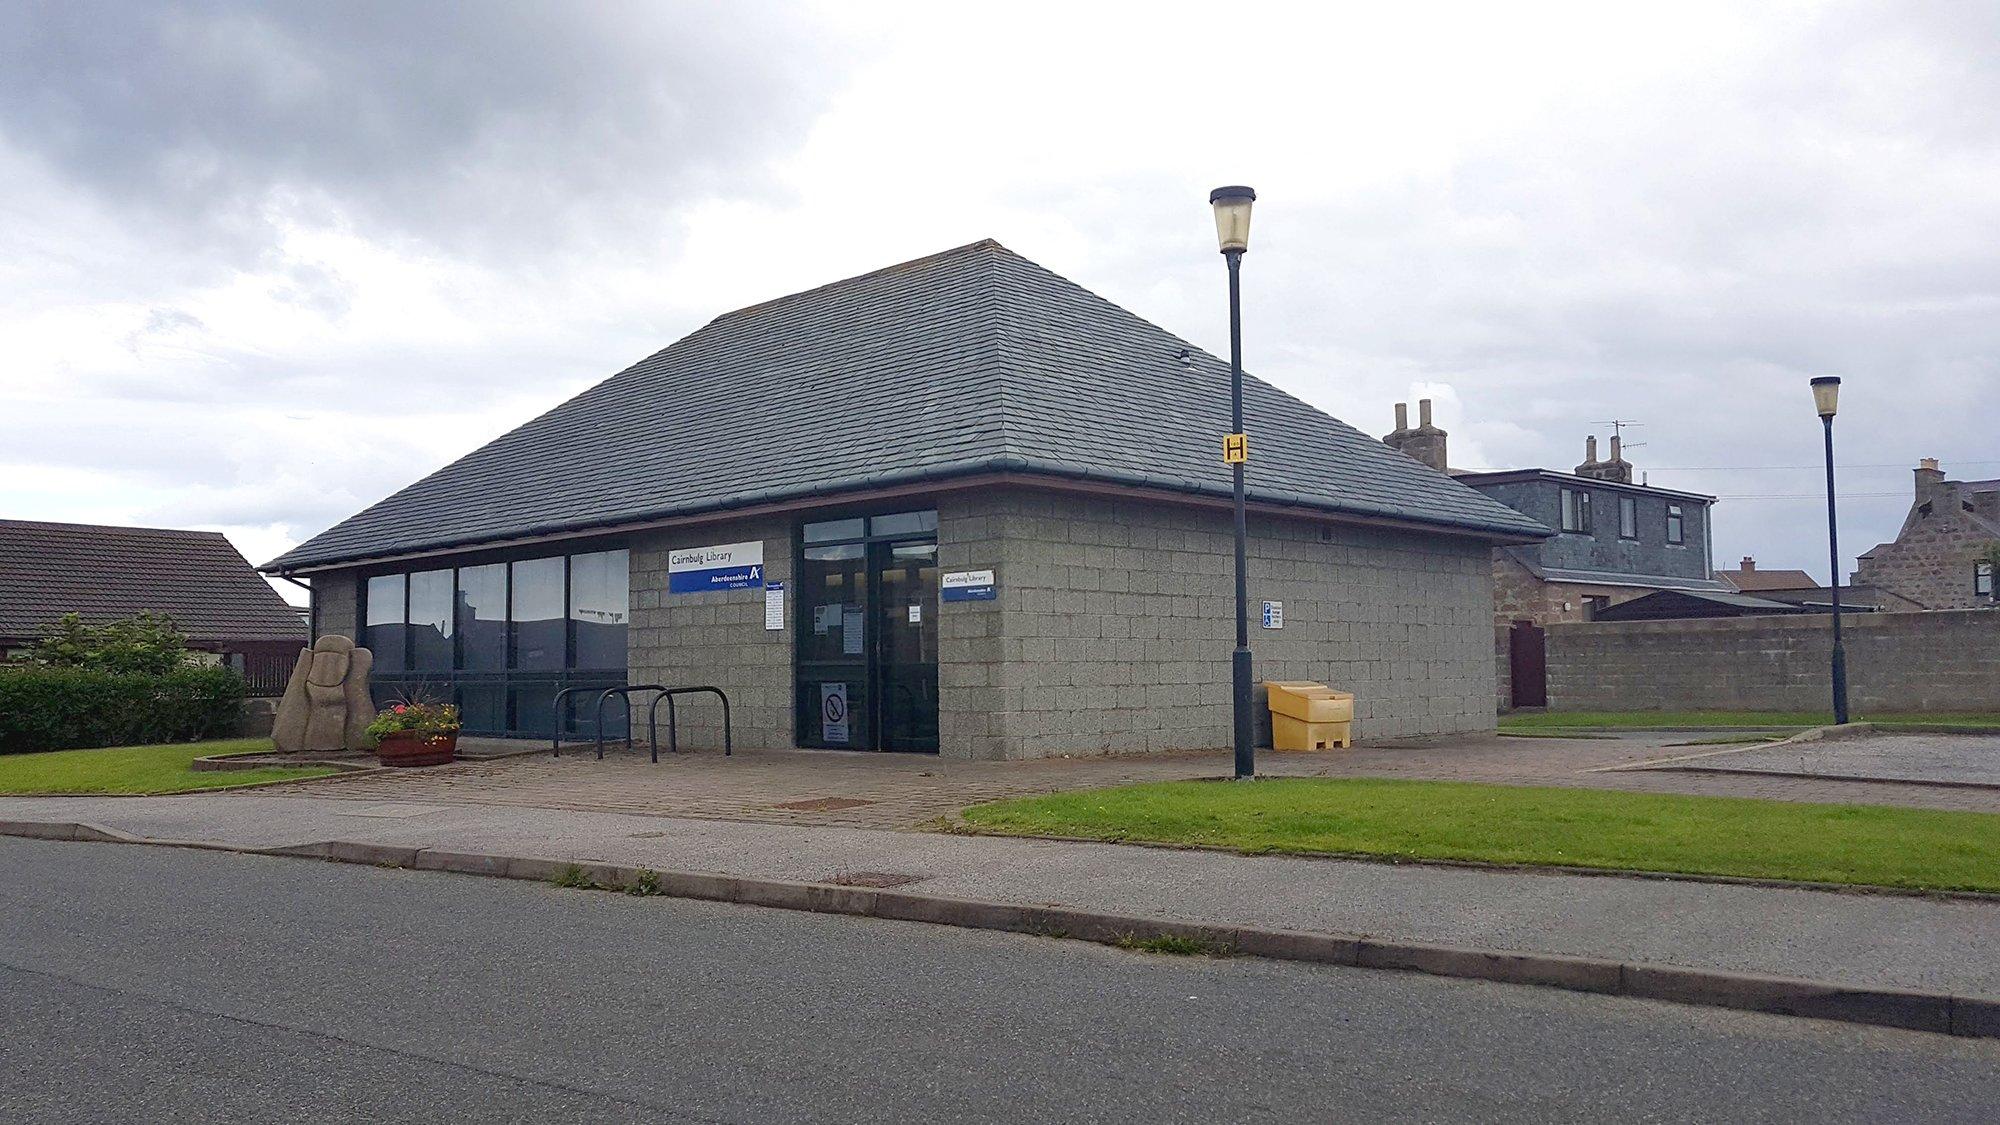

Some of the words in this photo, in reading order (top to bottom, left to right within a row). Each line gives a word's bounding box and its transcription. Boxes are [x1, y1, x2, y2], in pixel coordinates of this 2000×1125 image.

[1226, 437, 1243, 460] H
[672, 552, 704, 565] Cairnbulg
[706, 551, 732, 562] Library
[711, 574, 748, 582] Aberdeenshire
